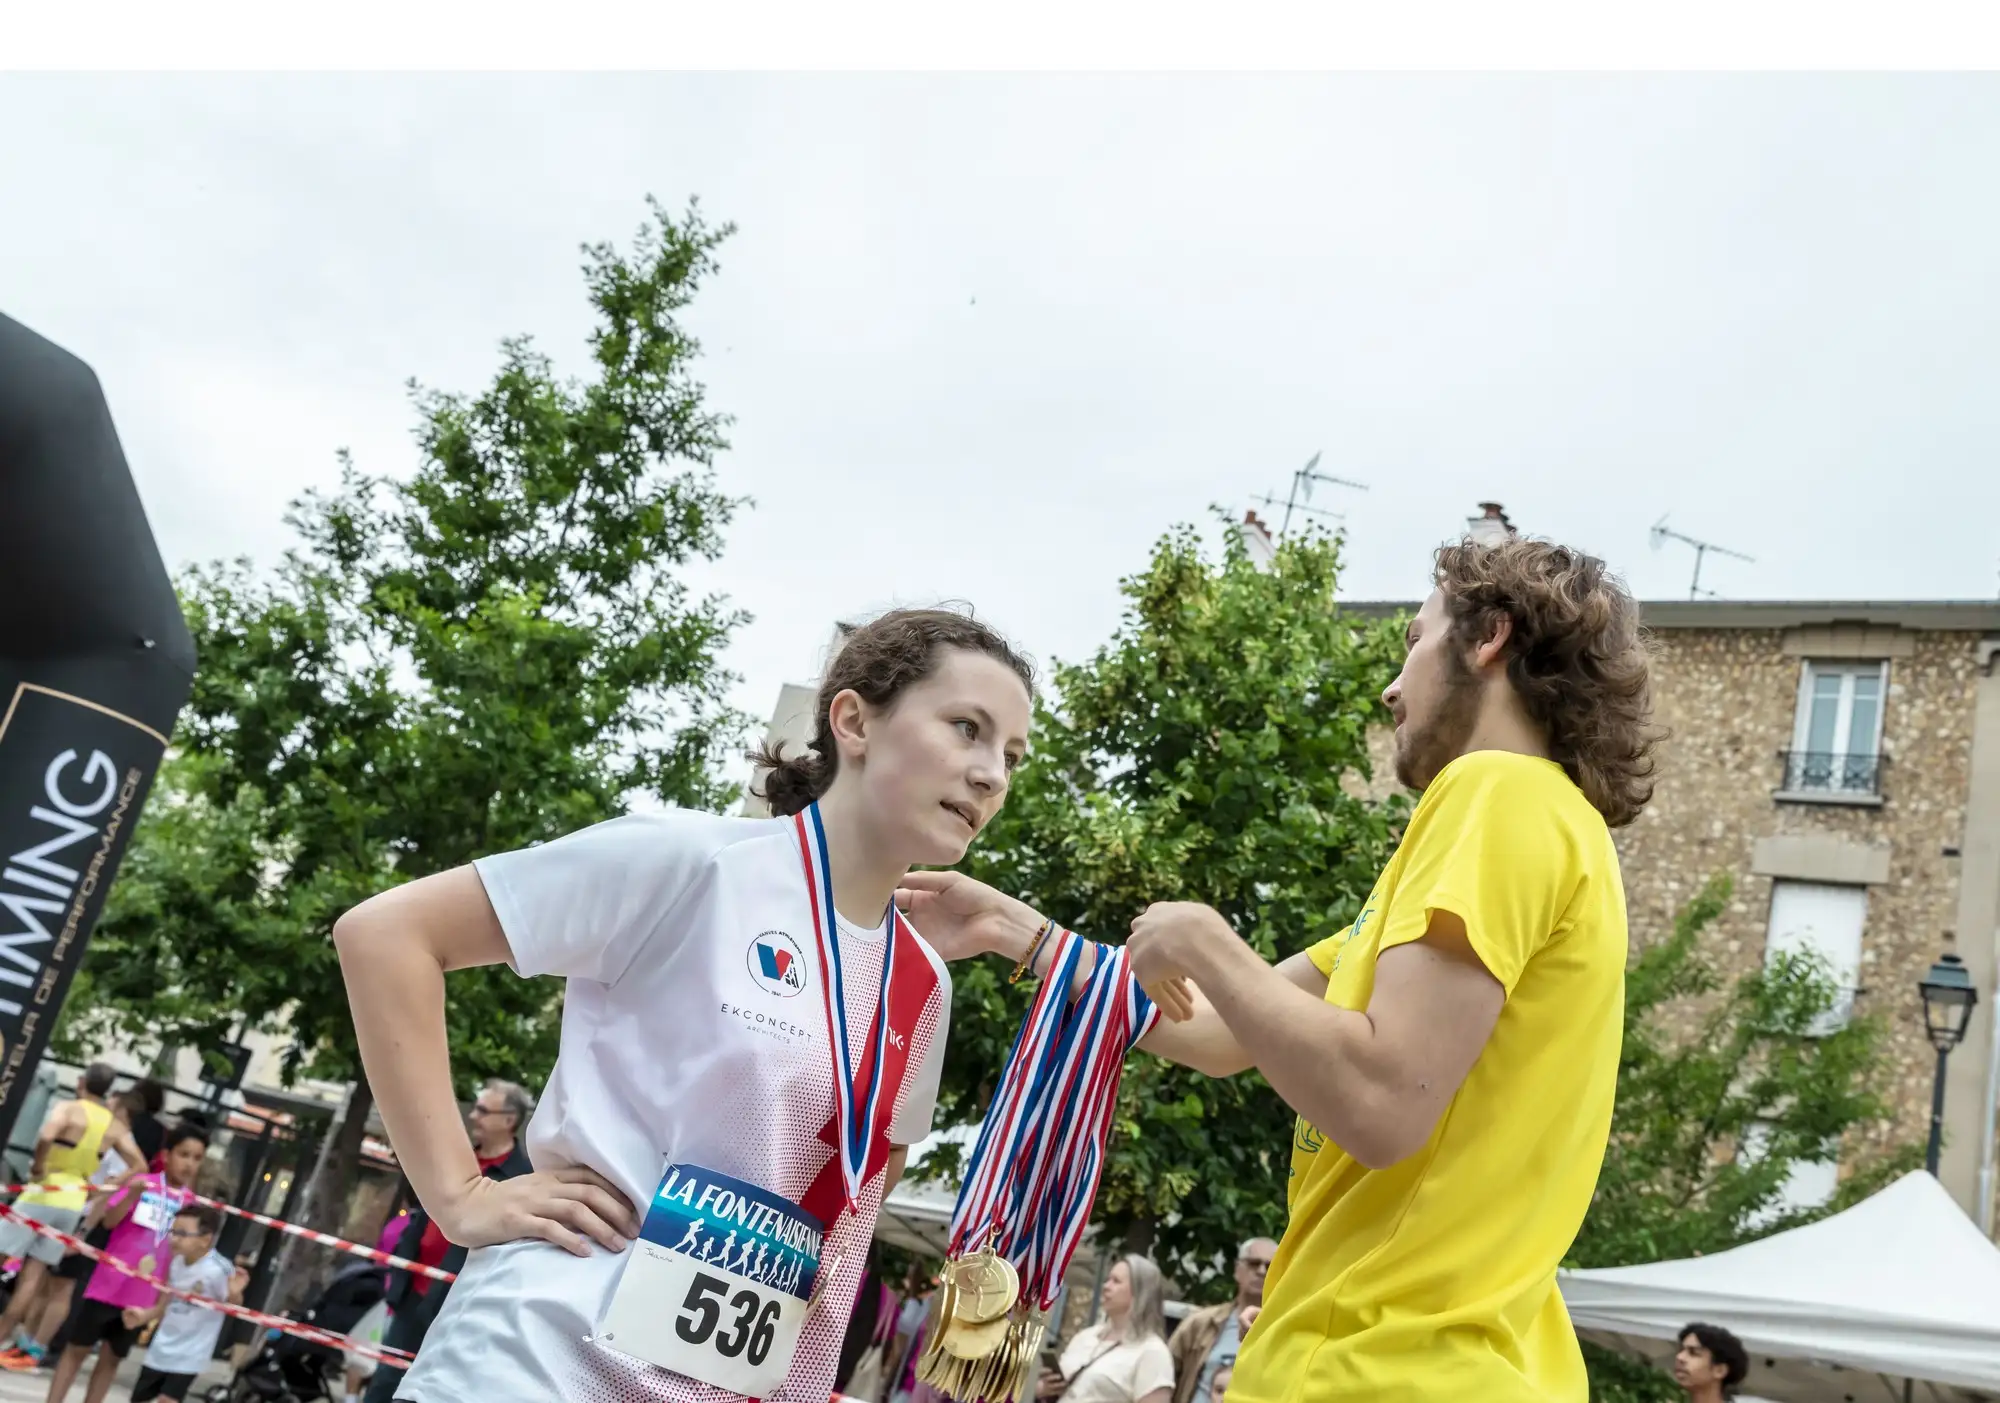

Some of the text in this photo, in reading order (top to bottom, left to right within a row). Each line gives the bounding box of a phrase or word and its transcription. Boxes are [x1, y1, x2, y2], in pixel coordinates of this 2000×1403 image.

[34, 965, 60, 1005] DE
[53, 767, 142, 962] PERFORMANCE
[720, 1003, 812, 1043] EKCONCEPT
[659, 1170, 697, 1206] LA
[675, 1271, 781, 1366] 536
